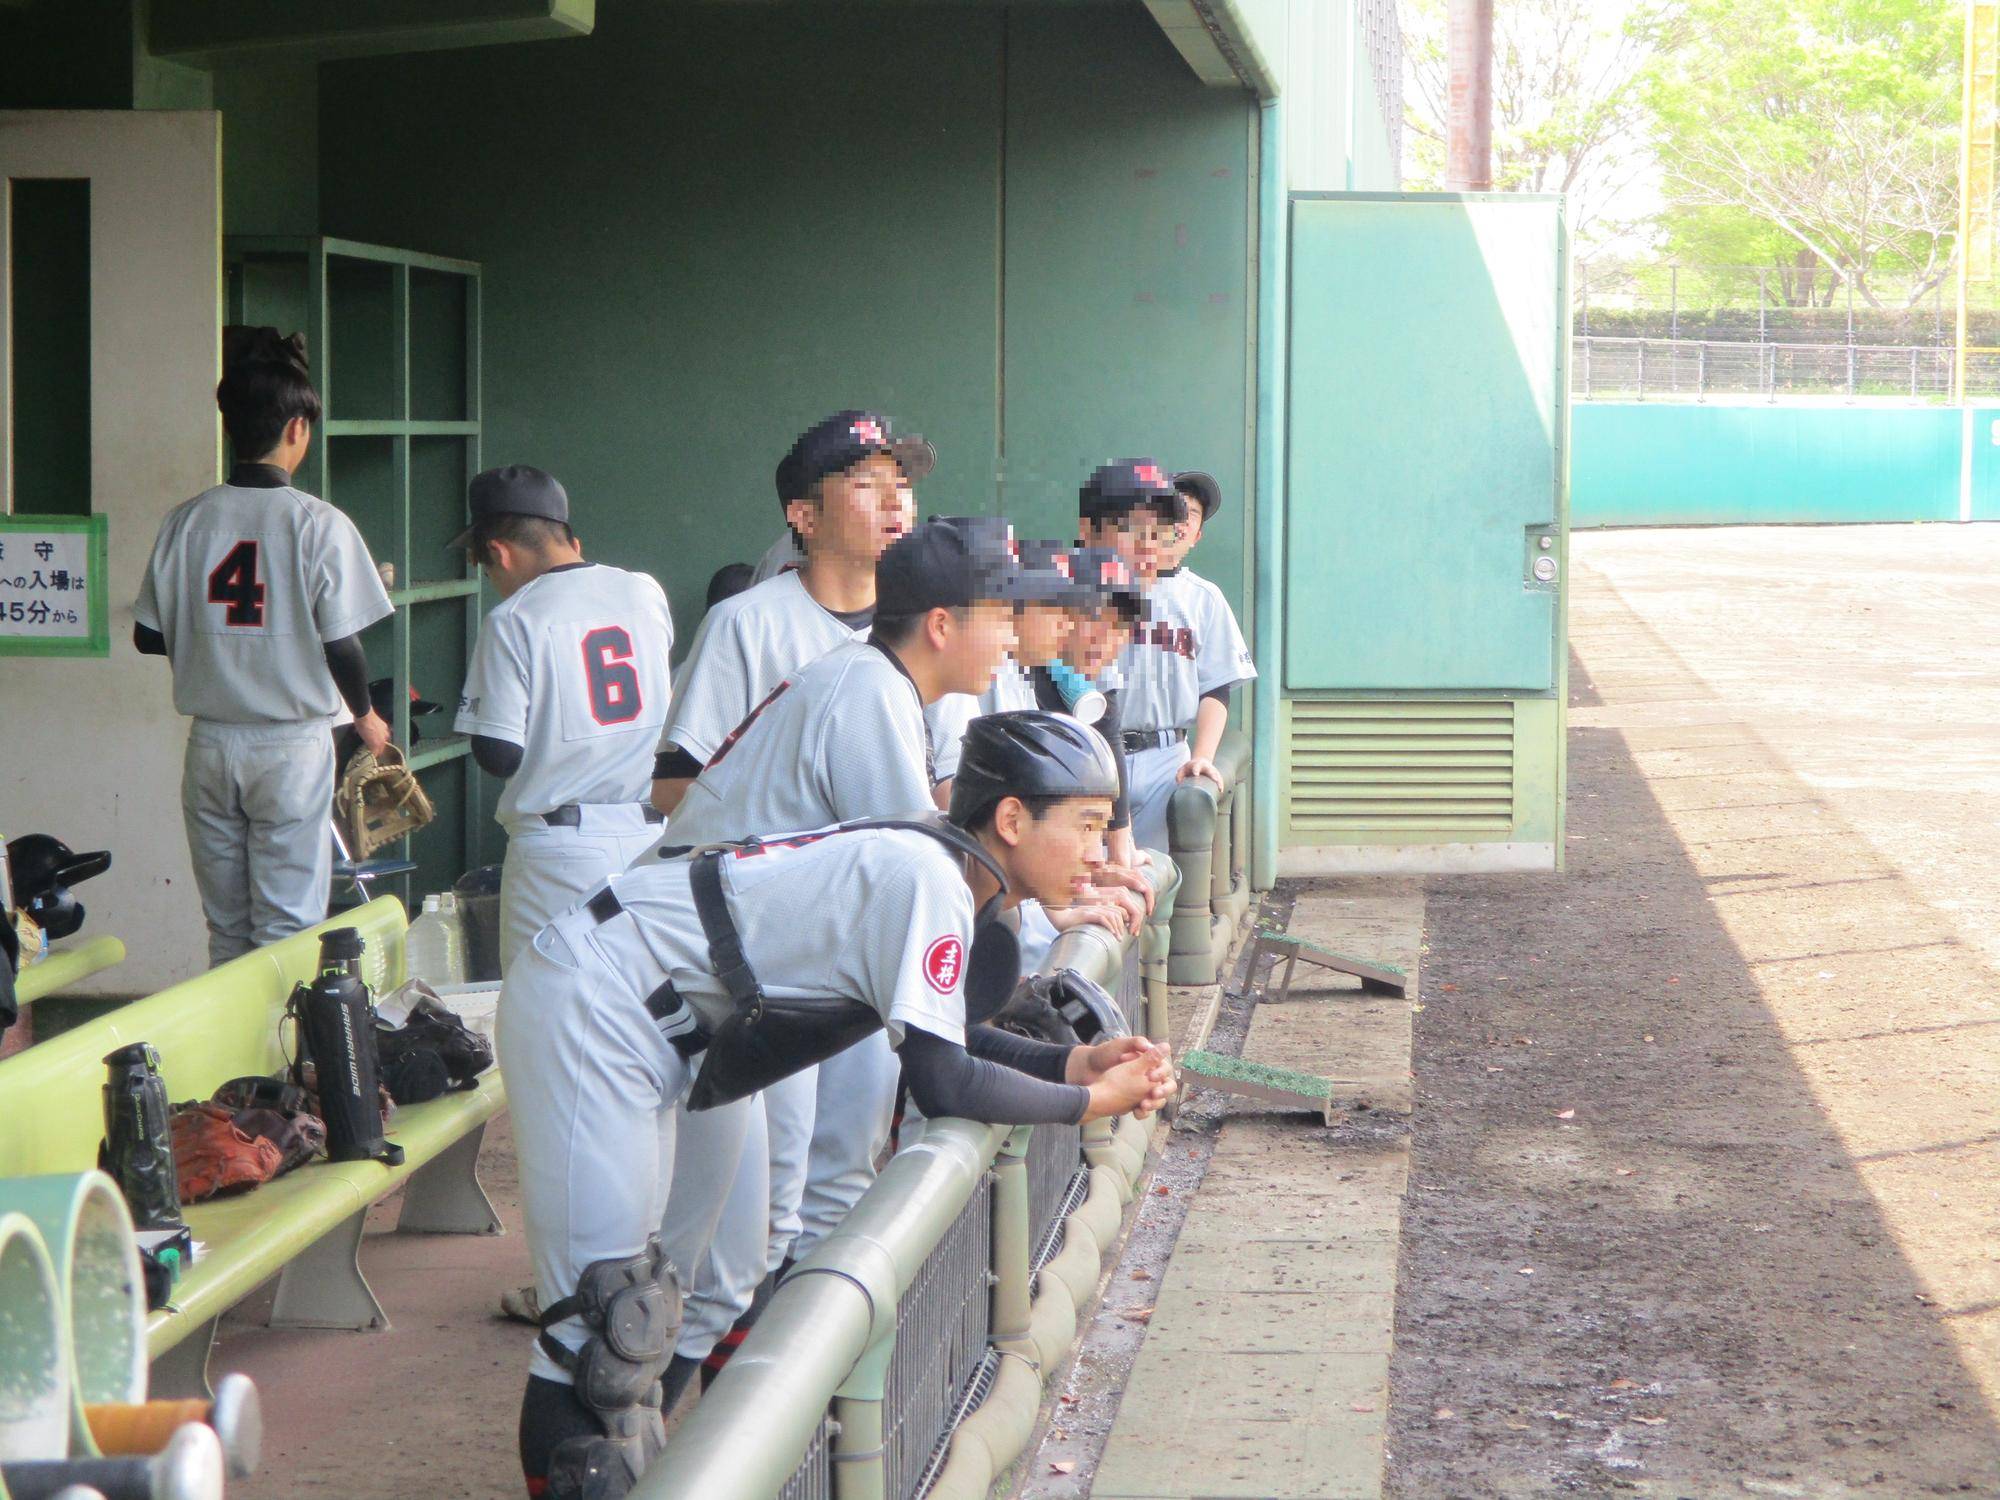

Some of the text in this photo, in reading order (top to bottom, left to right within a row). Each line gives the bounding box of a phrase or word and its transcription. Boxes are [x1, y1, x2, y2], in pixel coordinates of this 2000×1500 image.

[207, 540, 265, 628] 4
[581, 625, 643, 726] 6
[340, 1002, 361, 1097] SAHARA WIDE
